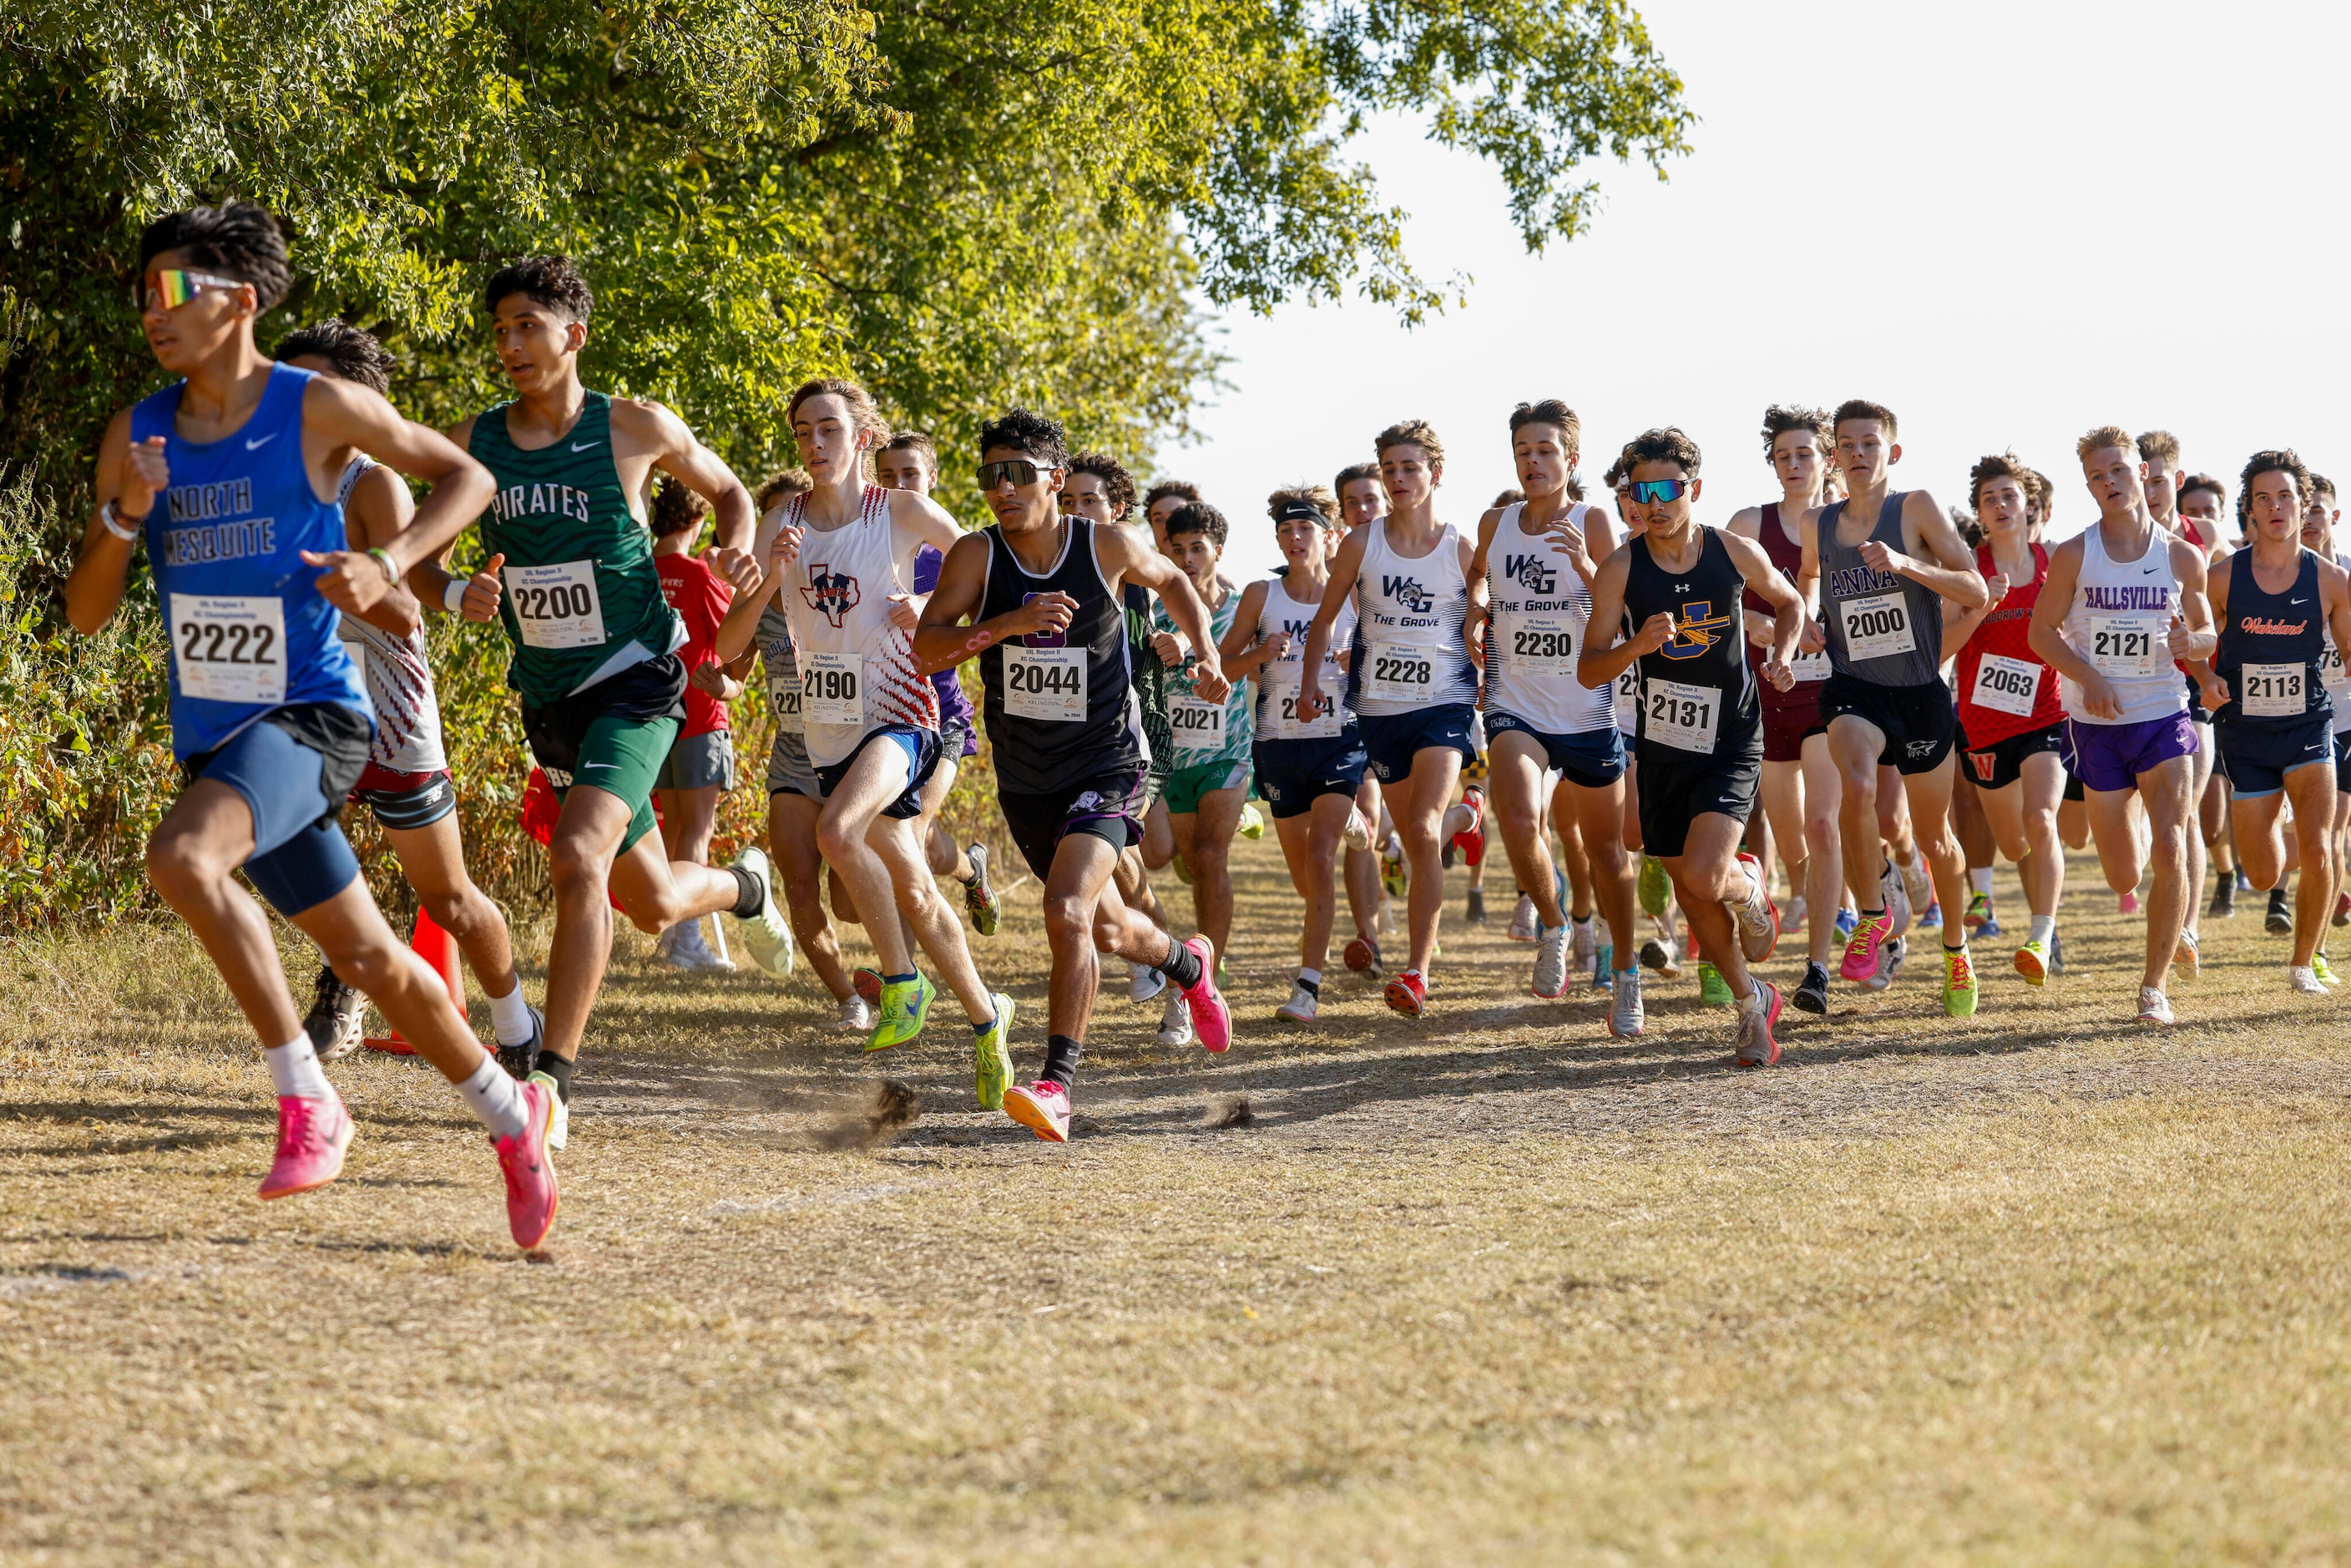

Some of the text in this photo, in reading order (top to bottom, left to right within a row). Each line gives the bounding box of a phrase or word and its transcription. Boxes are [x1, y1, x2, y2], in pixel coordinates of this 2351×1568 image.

[169, 477, 251, 523] NORTH
[492, 483, 589, 525] PIRATES
[163, 518, 276, 566] MESQUITE
[1831, 566, 1898, 597] ANNA
[514, 584, 592, 620] 2200
[1499, 599, 1570, 612] THE GROVE
[1860, 603, 1890, 611] Championship
[2084, 586, 2168, 610] HALLSVILLE
[1374, 613, 1439, 627] THE GROVE
[1848, 608, 1905, 639] 2000
[1979, 608, 2025, 625] OODROW
[2241, 616, 2308, 635] Wakeland
[181, 623, 276, 664] 2222
[1514, 631, 1571, 657] 2230
[2095, 632, 2149, 656] 2121
[1009, 663, 1081, 695] 2044
[1375, 657, 1431, 684] 2228
[1980, 666, 2033, 696] 2063
[805, 669, 857, 700] 2190
[1670, 690, 1704, 701] Championship
[2247, 675, 2300, 697] 2113
[1172, 707, 1219, 730] 2021
[1282, 695, 1335, 719] 24
[1651, 694, 1710, 729] 2131
[1968, 751, 1996, 781] W
